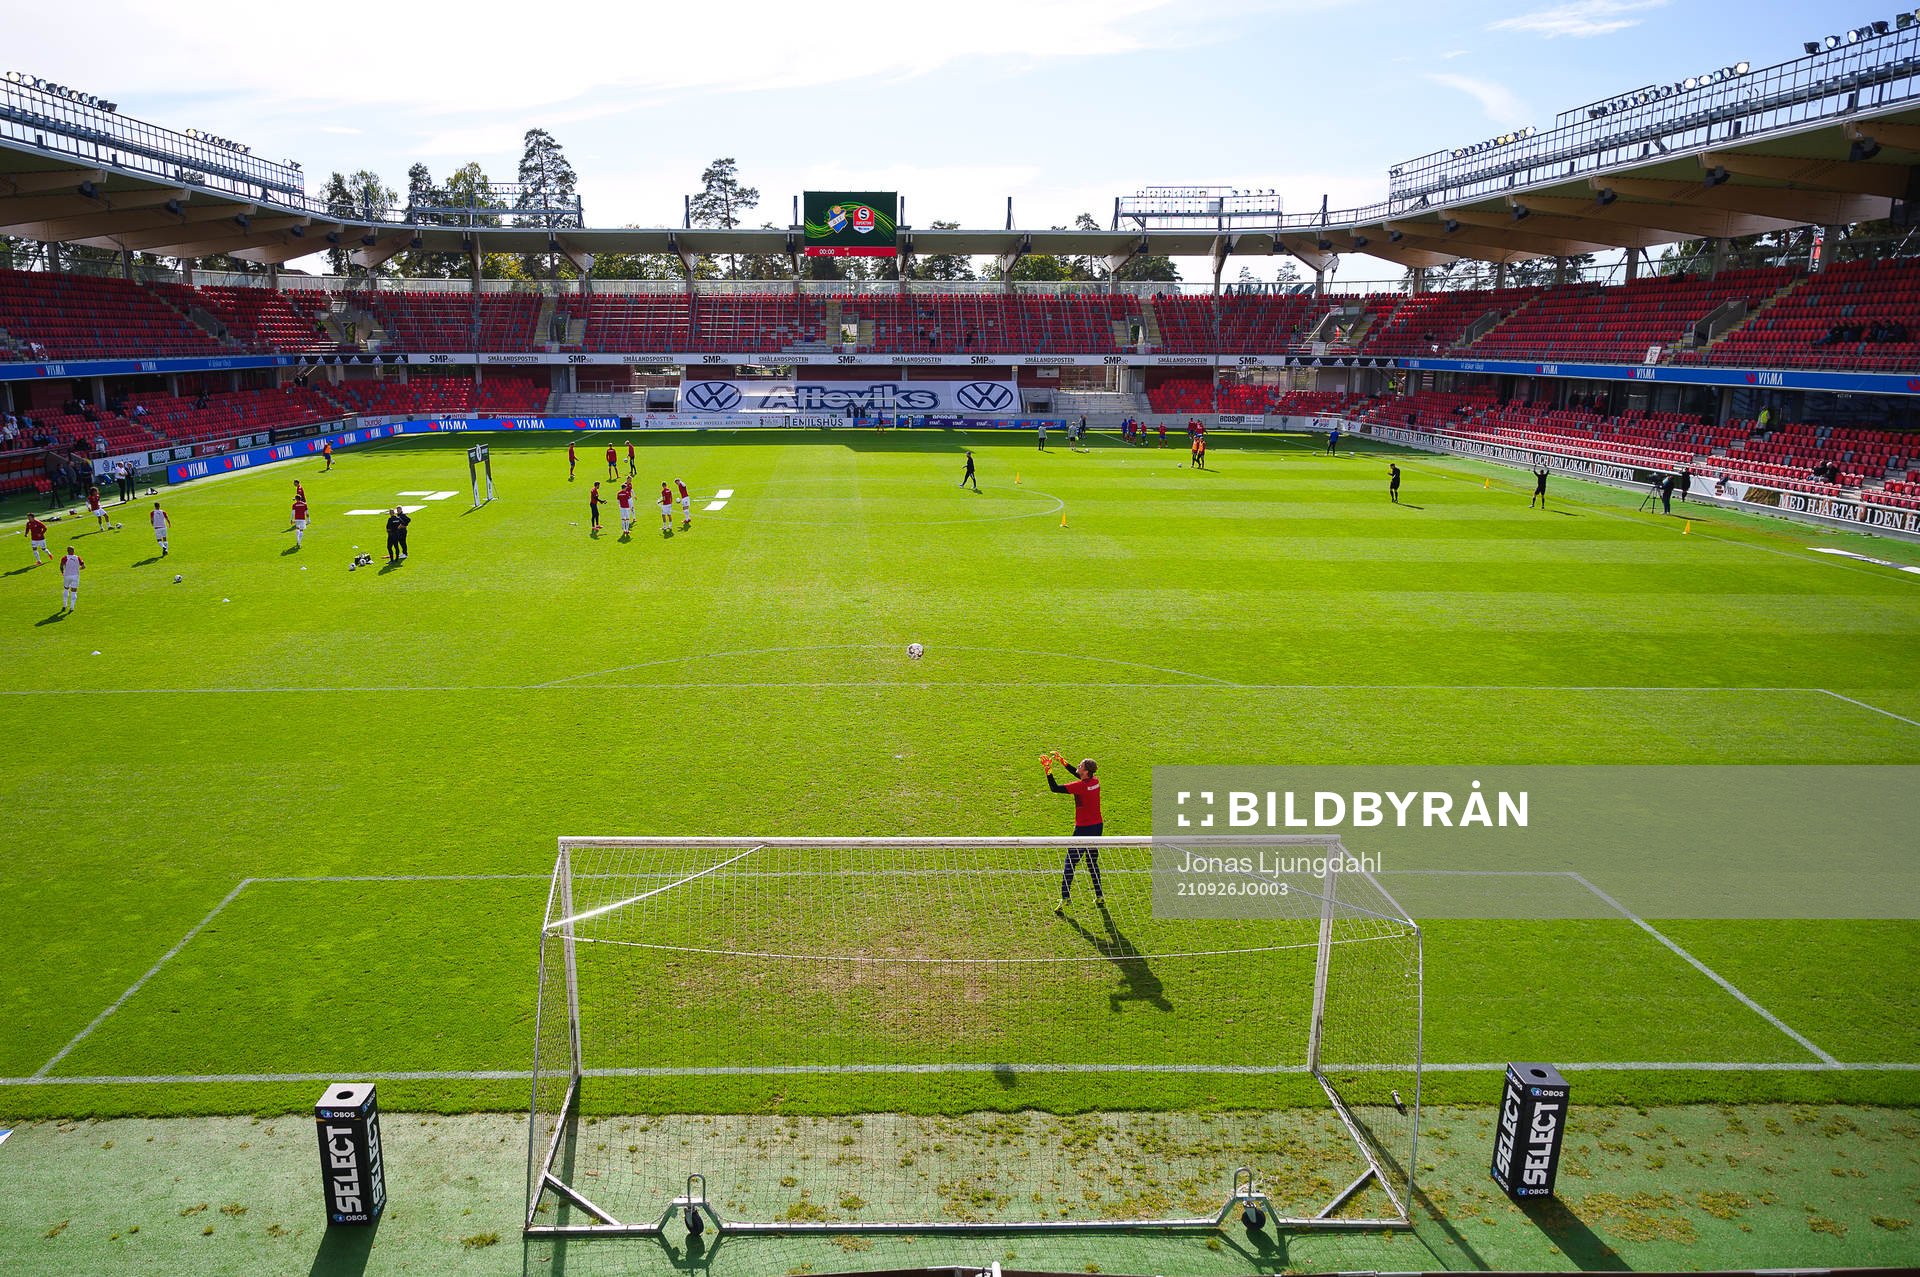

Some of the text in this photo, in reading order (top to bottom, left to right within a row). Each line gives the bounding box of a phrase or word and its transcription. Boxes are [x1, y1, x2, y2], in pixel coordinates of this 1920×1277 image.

[46, 365, 66, 376] VISMA
[141, 361, 157, 371] VISMA
[1543, 365, 1558, 375] VISMA
[1636, 368, 1655, 380] VISMA
[1758, 372, 1783, 386] VISMA
[439, 420, 468, 430] VISMA
[516, 419, 545, 429] VISMA
[589, 419, 617, 428] VISMA
[792, 418, 844, 427] EMILSHUS
[344, 432, 356, 444] VISMA
[370, 428, 381, 439] VISMA
[277, 445, 293, 458] VISMA
[232, 454, 250, 468] VISMA
[1534, 453, 1549, 466] OCH
[1549, 456, 1564, 468] DEN
[1564, 458, 1593, 474] LOKALA
[1593, 463, 1635, 481] IDROTTEN
[188, 460, 209, 477] VISMA
[1778, 493, 1805, 512] MED
[1865, 509, 1873, 523] I
[1872, 510, 1904, 529] DEN
[1496, 1084, 1521, 1179] SELECT
[1522, 1102, 1560, 1185] SELECT
[366, 1111, 383, 1205] SELECT
[326, 1125, 363, 1213] SELECT
[345, 1214, 368, 1222] OBOS
